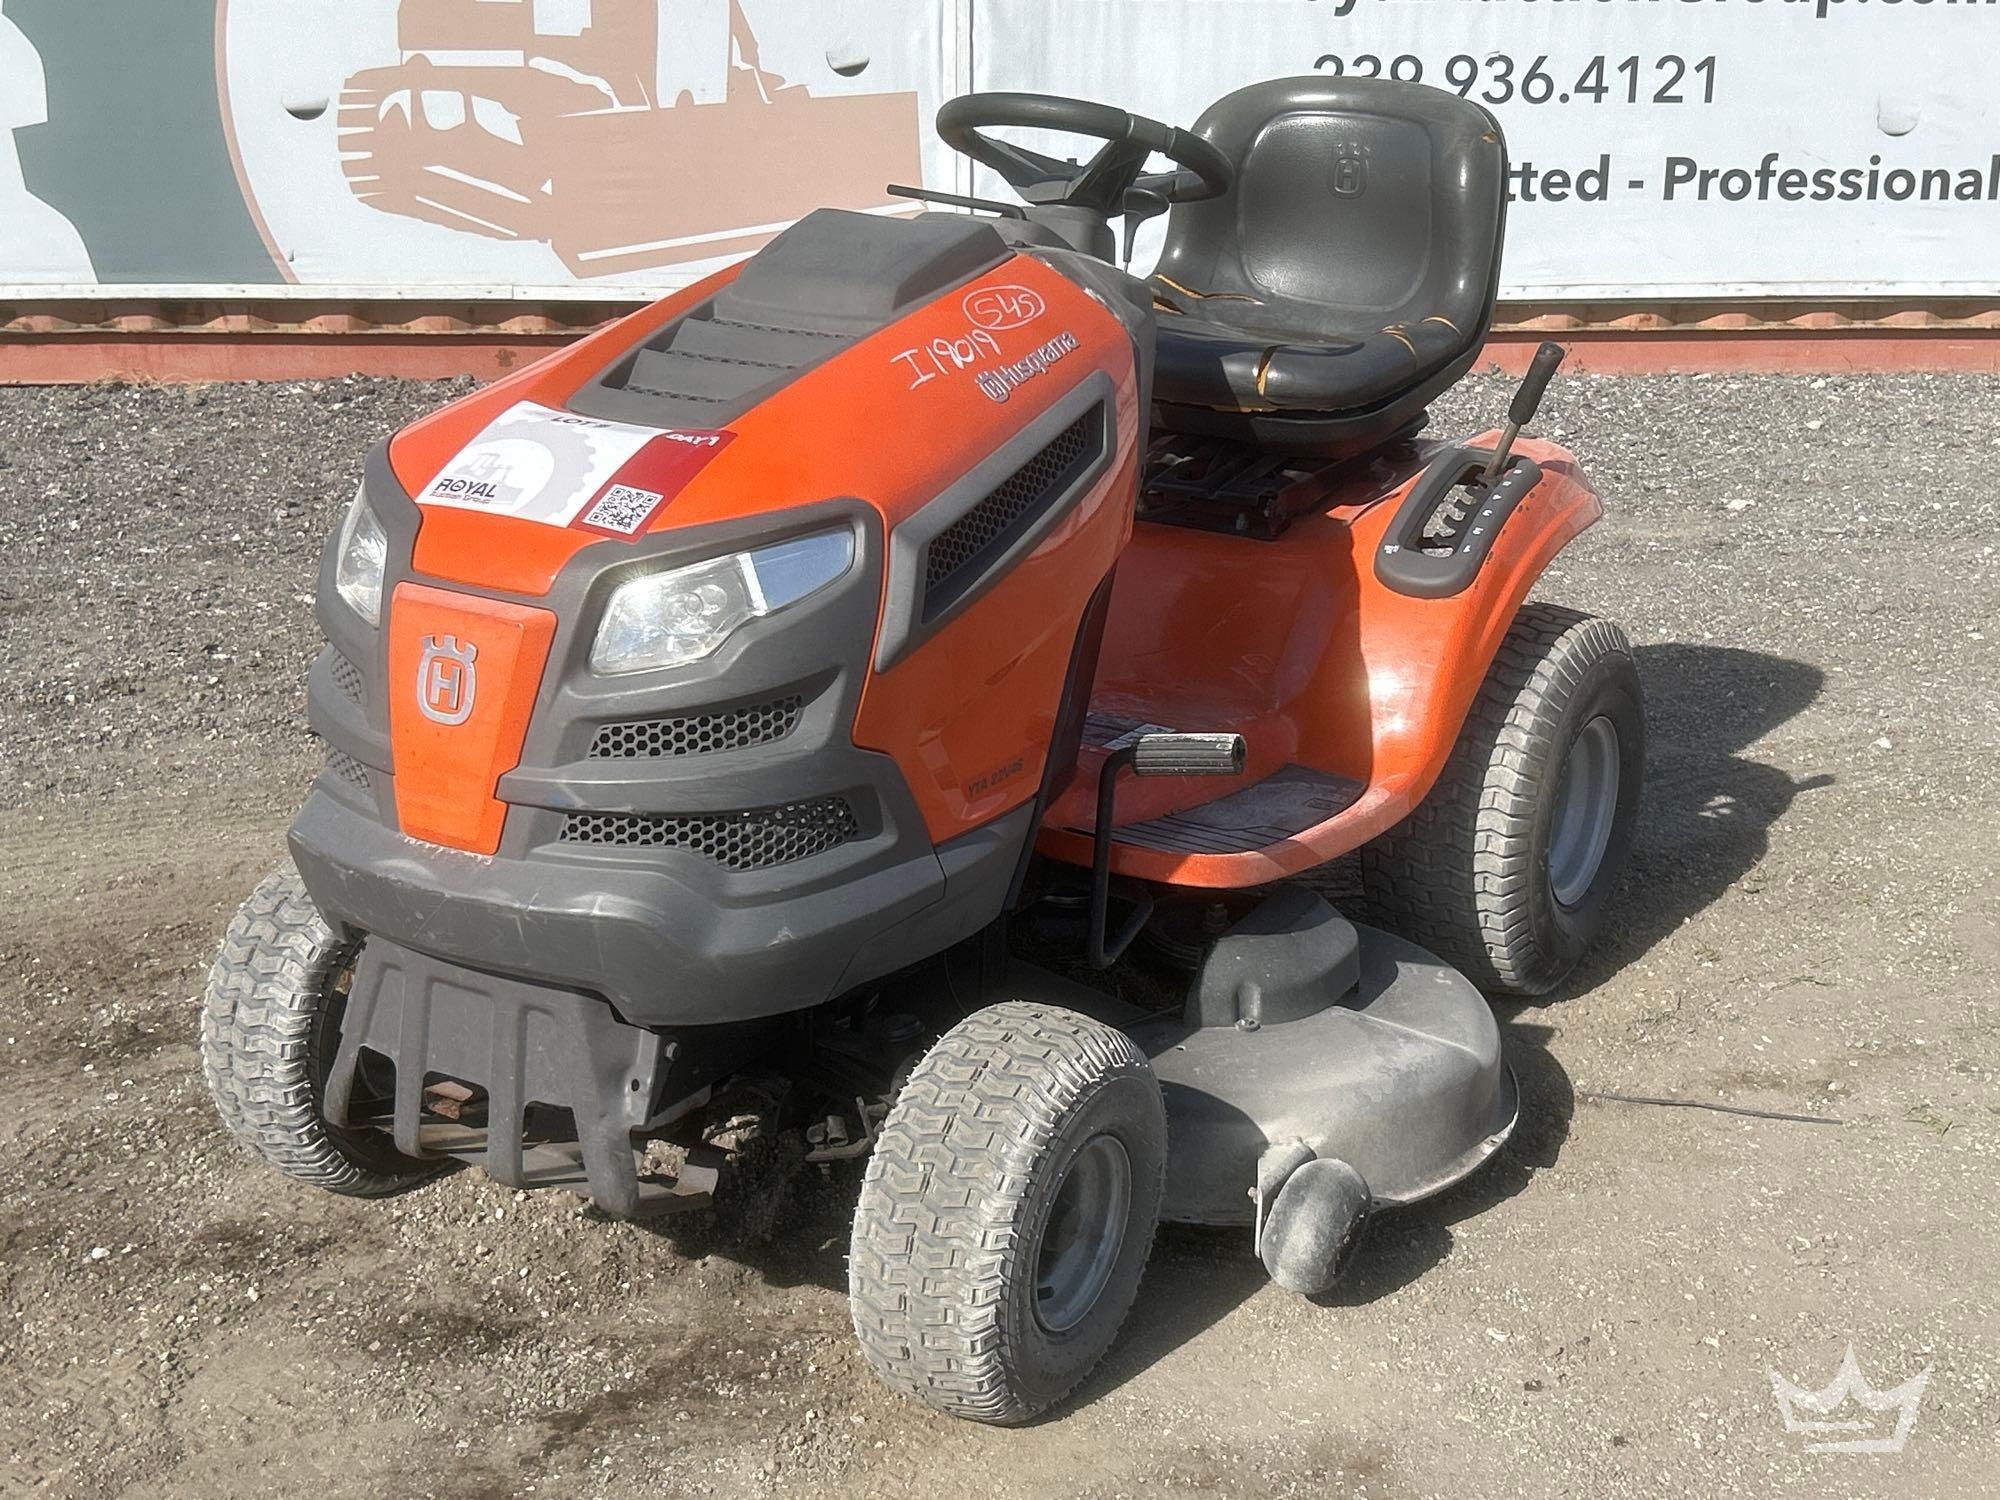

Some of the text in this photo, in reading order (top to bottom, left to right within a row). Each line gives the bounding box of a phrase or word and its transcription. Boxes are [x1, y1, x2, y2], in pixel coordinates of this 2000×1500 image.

[1664, 153, 2000, 202] Professional
[992, 330, 1080, 391] Husqvarna
[434, 478, 497, 498] ROYAL
